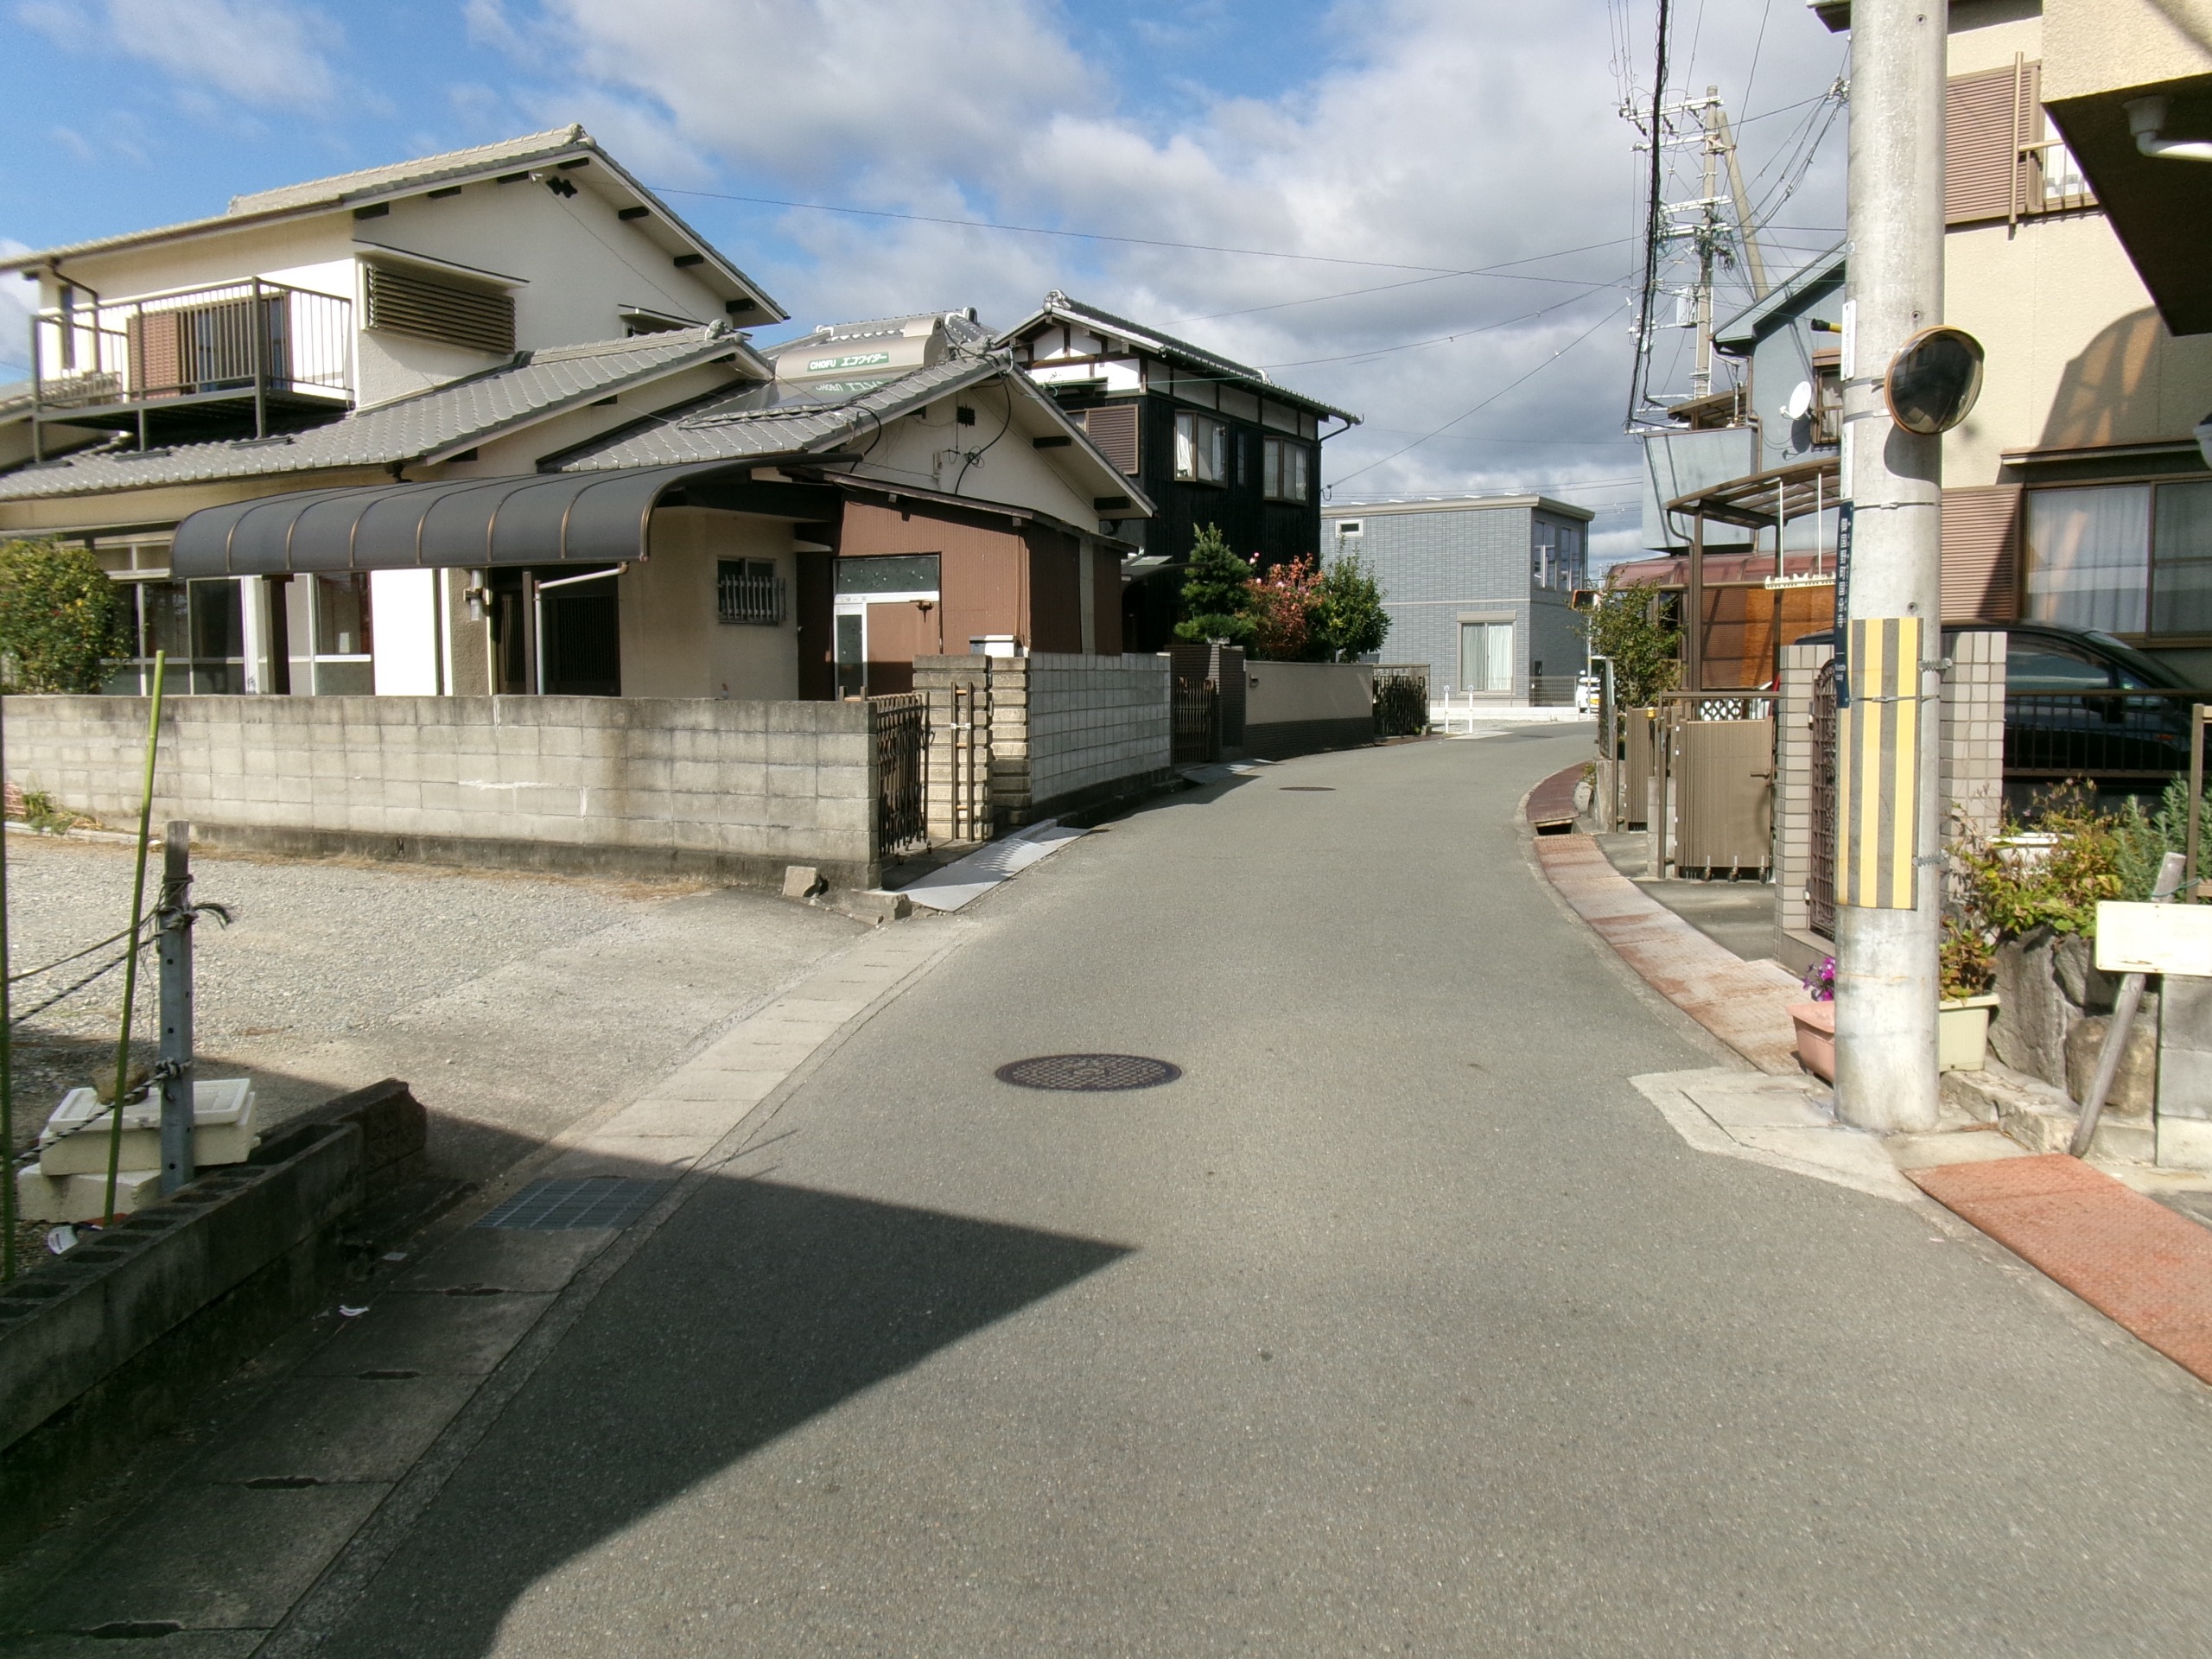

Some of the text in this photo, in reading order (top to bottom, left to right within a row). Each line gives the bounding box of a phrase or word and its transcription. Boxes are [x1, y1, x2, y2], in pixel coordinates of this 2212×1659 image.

[810, 353, 887, 370] CHOFU エコワイター
